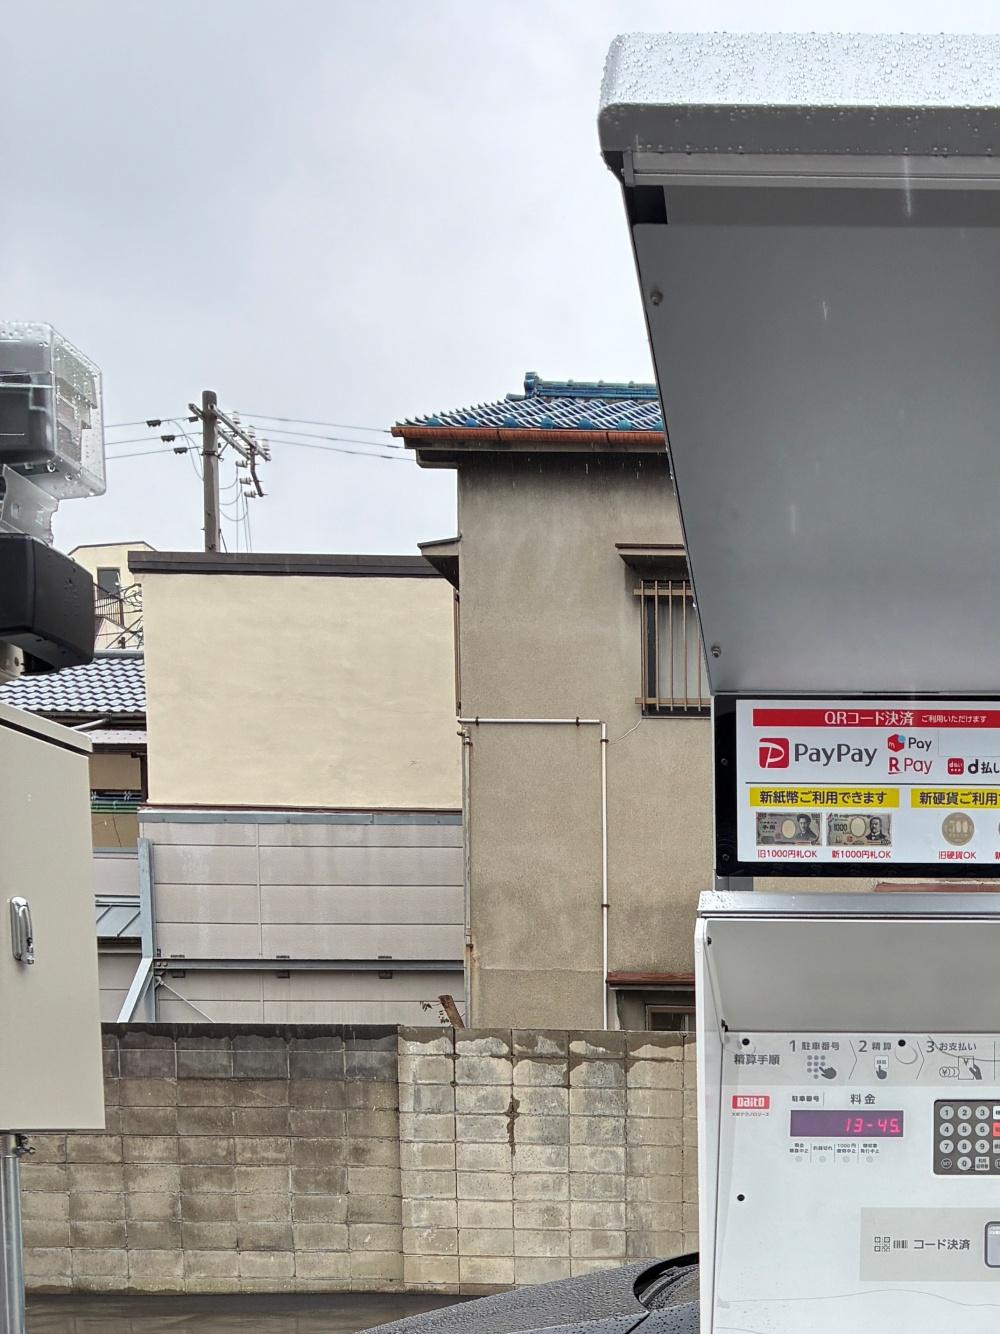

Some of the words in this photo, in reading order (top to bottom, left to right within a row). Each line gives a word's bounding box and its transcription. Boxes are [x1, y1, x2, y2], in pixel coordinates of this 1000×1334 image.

[824, 711, 914, 725] QRコード決済
[921, 714, 987, 723] ご利用いただけます
[908, 737, 932, 752] Pay
[794, 743, 878, 767] PayPay
[904, 758, 933, 775] Pay
[759, 790, 887, 805] 新紙幣ご利用できます
[757, 849, 818, 858] 旧1000円札OK
[831, 850, 892, 859] 新1000円札OK
[938, 851, 977, 860] 旧硬貨OK
[801, 1041, 840, 1051] 駐車番号
[858, 1040, 868, 1053] 2
[926, 1041, 935, 1053] 3
[940, 1042, 977, 1051] お支払い
[734, 1053, 781, 1065] 精算手順
[850, 1093, 876, 1105] 料金
[913, 1238, 970, 1250] コード決済
